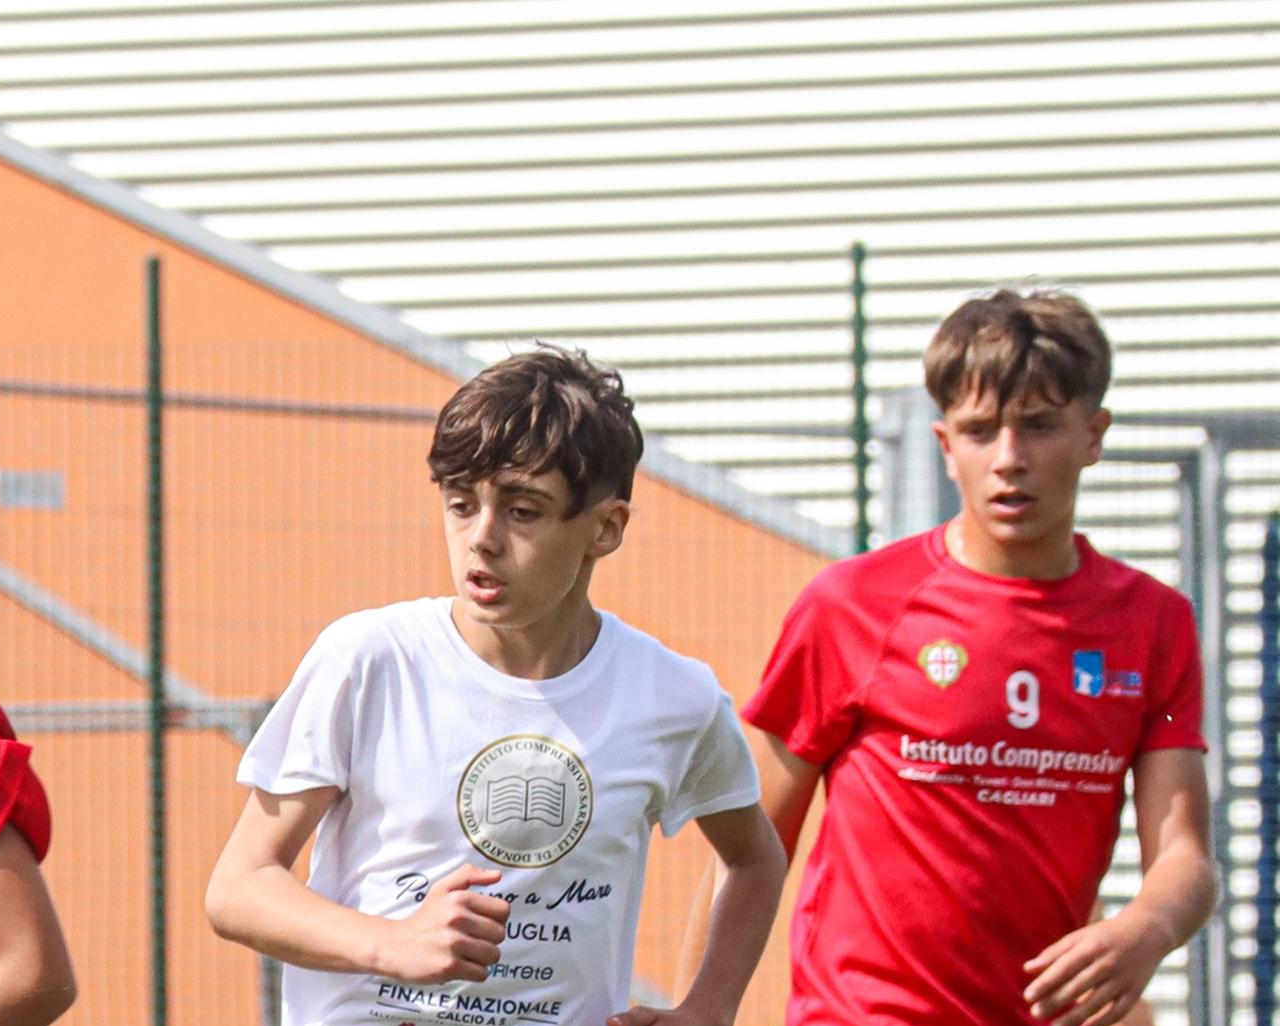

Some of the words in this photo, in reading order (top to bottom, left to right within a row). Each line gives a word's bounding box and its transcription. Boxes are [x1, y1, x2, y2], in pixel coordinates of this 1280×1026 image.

[1006, 670, 1040, 729] 9
[469, 744, 513, 784] ISTITUTO
[514, 741, 587, 792] COMPRENSIVO
[901, 734, 988, 766] Istituto
[991, 740, 1125, 774] Comprensiv
[977, 790, 1057, 806] CAGLIARI
[525, 892, 541, 904] a
[507, 922, 571, 942] UGLIA
[378, 984, 450, 1009] FINALE
[456, 995, 562, 1016] NAZIONALE
[437, 1011, 484, 1026] CALCIO
[487, 1016, 497, 1026] A
